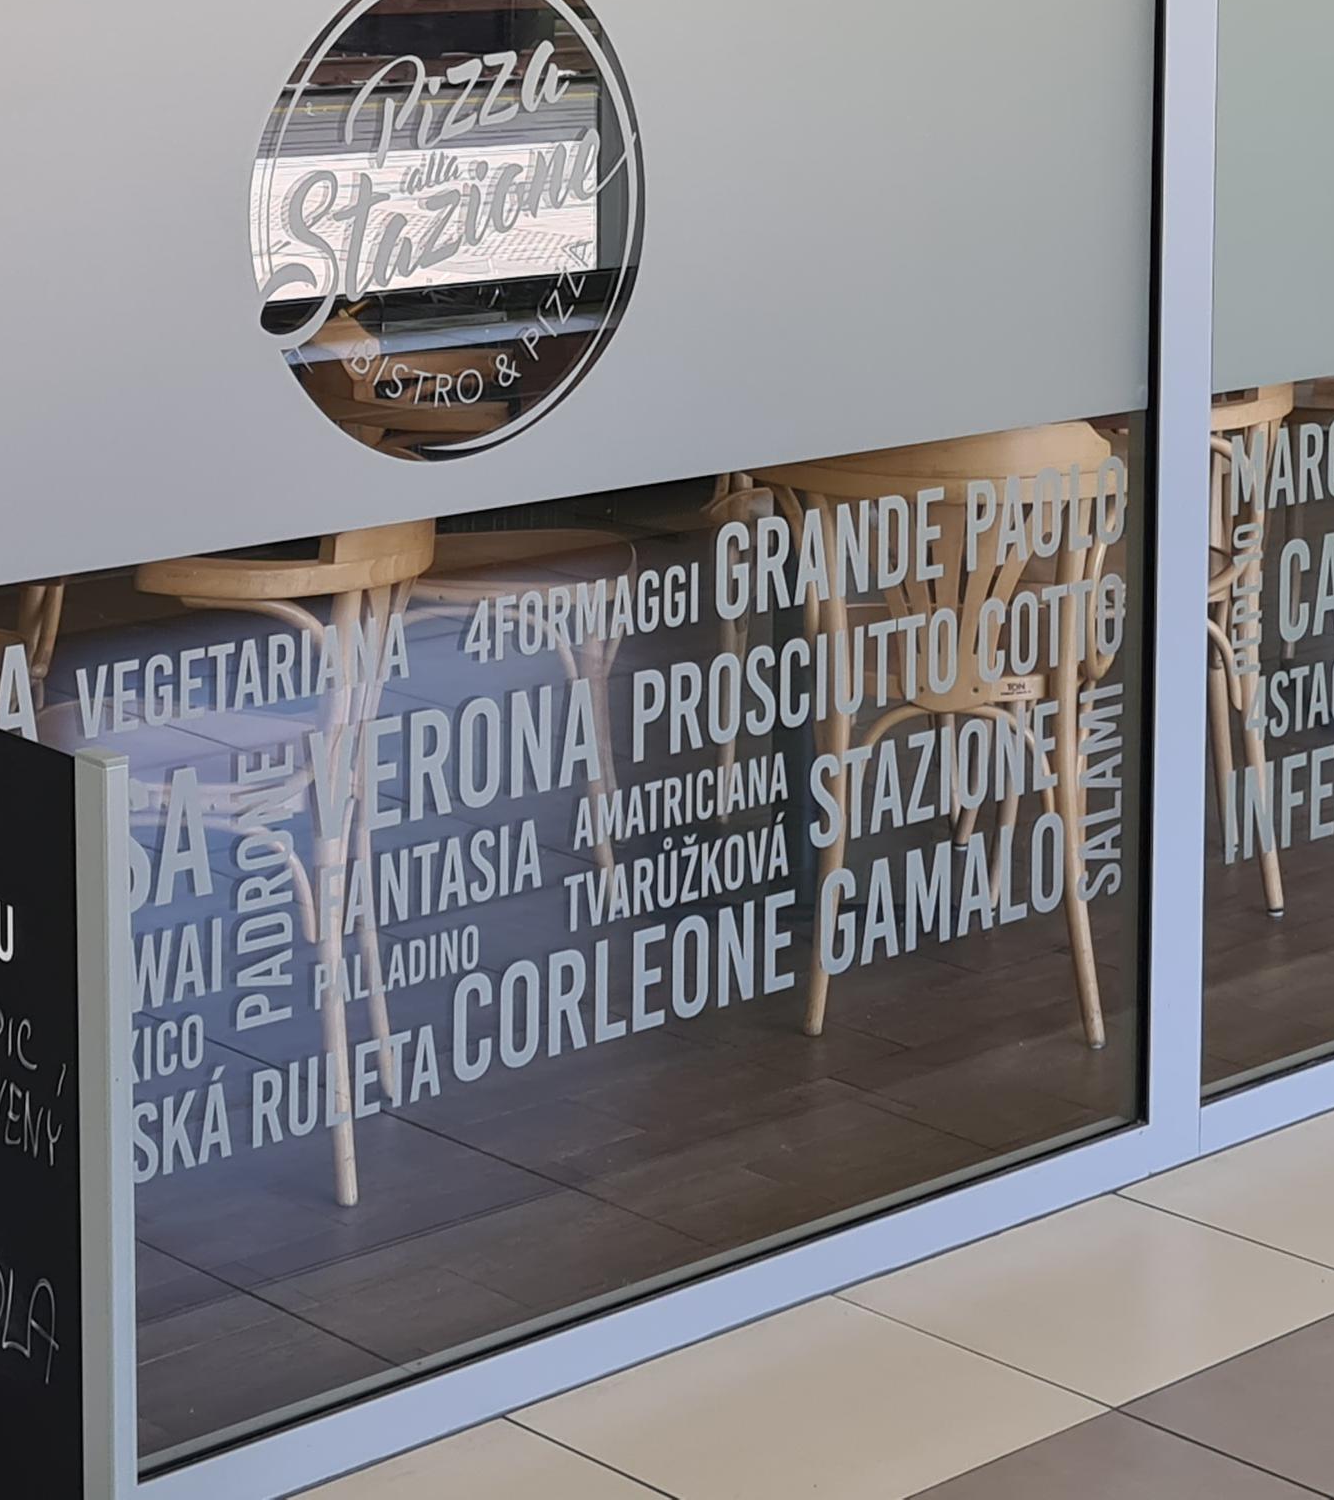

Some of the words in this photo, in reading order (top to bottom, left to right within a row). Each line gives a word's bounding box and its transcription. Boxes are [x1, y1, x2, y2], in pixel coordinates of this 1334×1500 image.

[345, 40, 574, 167] Pizza
[261, 128, 612, 350] Stazione
[349, 338, 484, 408] BISTRO
[495, 353, 522, 388] &
[520, 240, 594, 362] PIZZA
[76, 613, 410, 739] VEGETARIANA
[464, 562, 700, 664] 4FORMAGGI
[715, 486, 945, 621] GRANDE
[967, 455, 1126, 572] PAOLO
[311, 679, 601, 844] VERONA
[632, 607, 958, 763] PROSCIUTTO
[978, 572, 1124, 683] COTTO
[236, 743, 295, 1033] PADRONE
[319, 819, 544, 942] FANTASIA
[573, 752, 789, 851] AMATRICIANA
[809, 700, 1060, 849] STAZIONE
[1077, 682, 1124, 902] SALAMI
[251, 1024, 443, 1149] RULETA
[452, 889, 796, 1082] CORLEONE
[817, 811, 1065, 975] GAMALO
[313, 924, 482, 1009] PALLADINO
[563, 836, 790, 932] TVARŮŽKOVÁ
